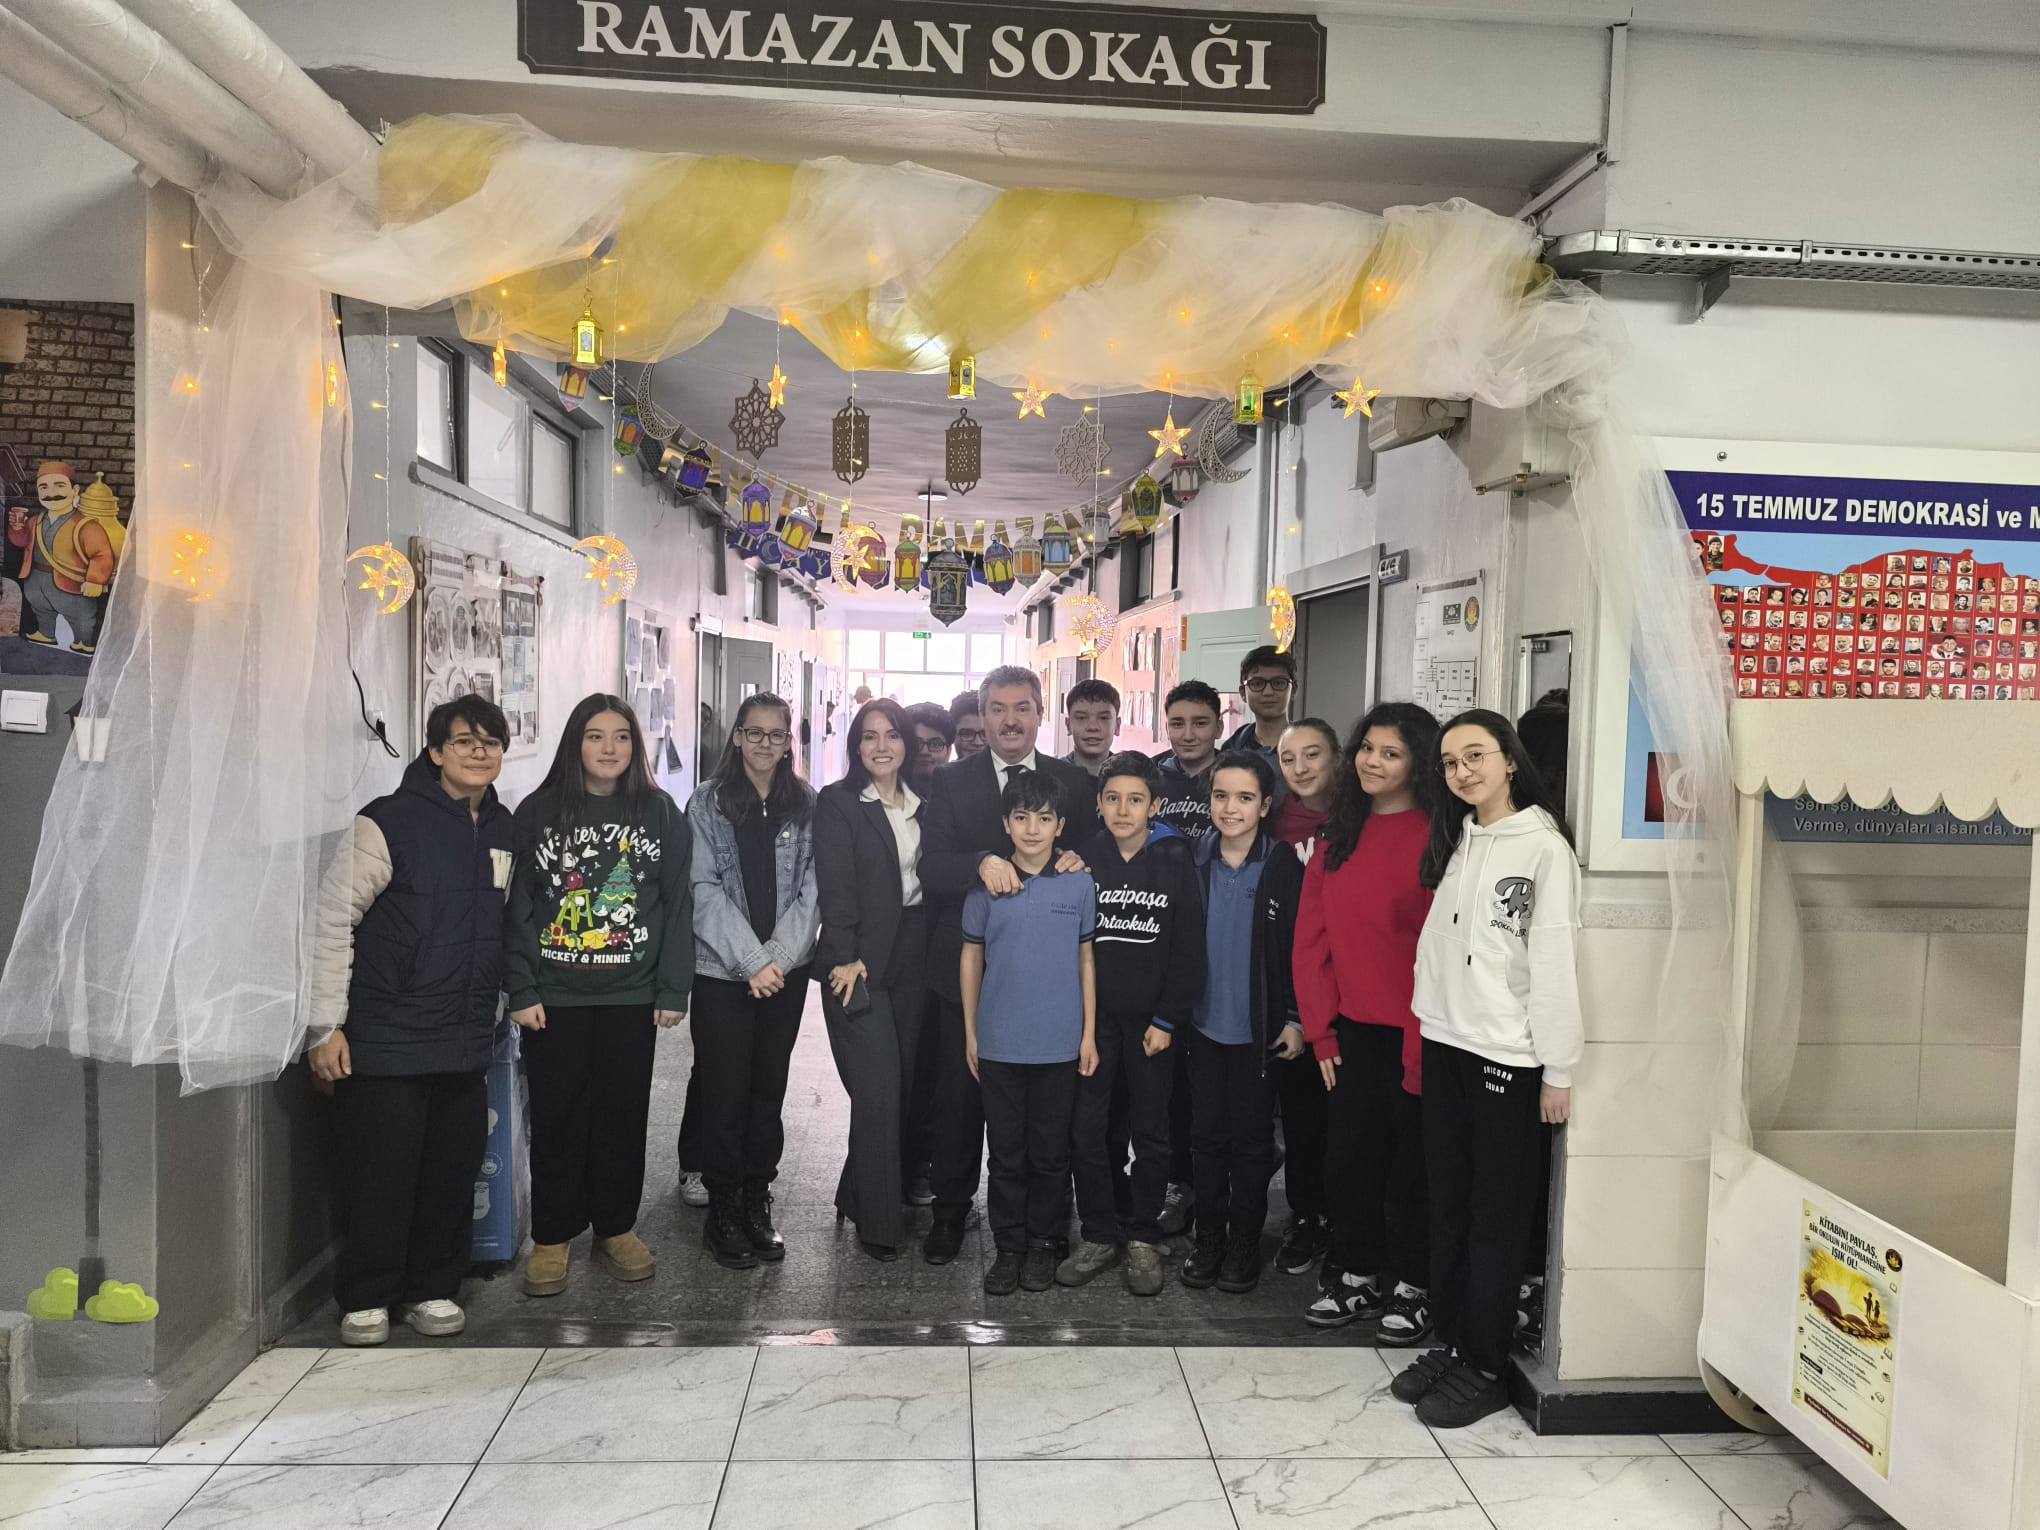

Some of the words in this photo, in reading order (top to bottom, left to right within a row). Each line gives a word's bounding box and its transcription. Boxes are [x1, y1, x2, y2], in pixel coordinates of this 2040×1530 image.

[577, 0, 972, 74] RAMAZAN
[989, 22, 1272, 91] SOKAĞI
[1696, 492, 1725, 518] 15
[1732, 494, 1839, 522] TEMMUZ
[1845, 498, 1990, 528] DEMOKRASİ
[1996, 509, 2023, 529] ve
[1793, 817, 1850, 834] Verme,
[1854, 818, 1932, 837] dünyaları
[1935, 820, 1979, 835] alsan
[1983, 821, 2008, 838] da,
[633, 926, 649, 943] 28
[541, 947, 579, 963] MICKEY
[580, 953, 590, 964] &
[593, 953, 632, 964] MINNIE
[1819, 1215, 1849, 1242] KİTABINI
[1849, 1233, 1878, 1260] PAYLAŞ,
